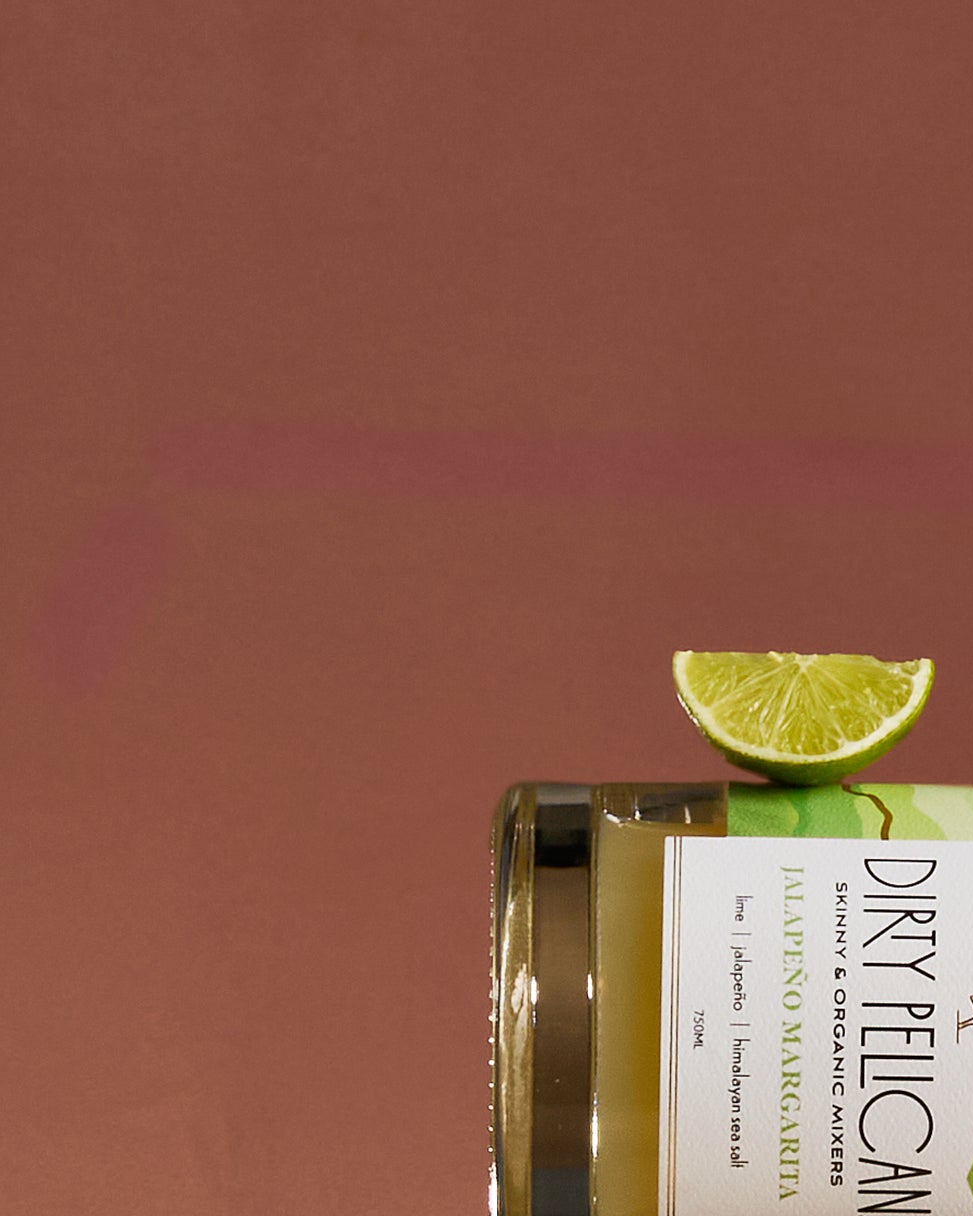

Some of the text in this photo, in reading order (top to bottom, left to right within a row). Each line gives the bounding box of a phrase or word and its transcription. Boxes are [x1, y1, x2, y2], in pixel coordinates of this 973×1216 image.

[693, 1010, 705, 1049] 750ML
[728, 895, 754, 1168] lime jalapeño himalayan sea salt
[779, 866, 808, 1201] JALAPEÑO MARGARITA
[830, 882, 848, 1186] SKINNY & ORGANIC MIXERS
[857, 858, 937, 1214] DIRTY PELICAN
